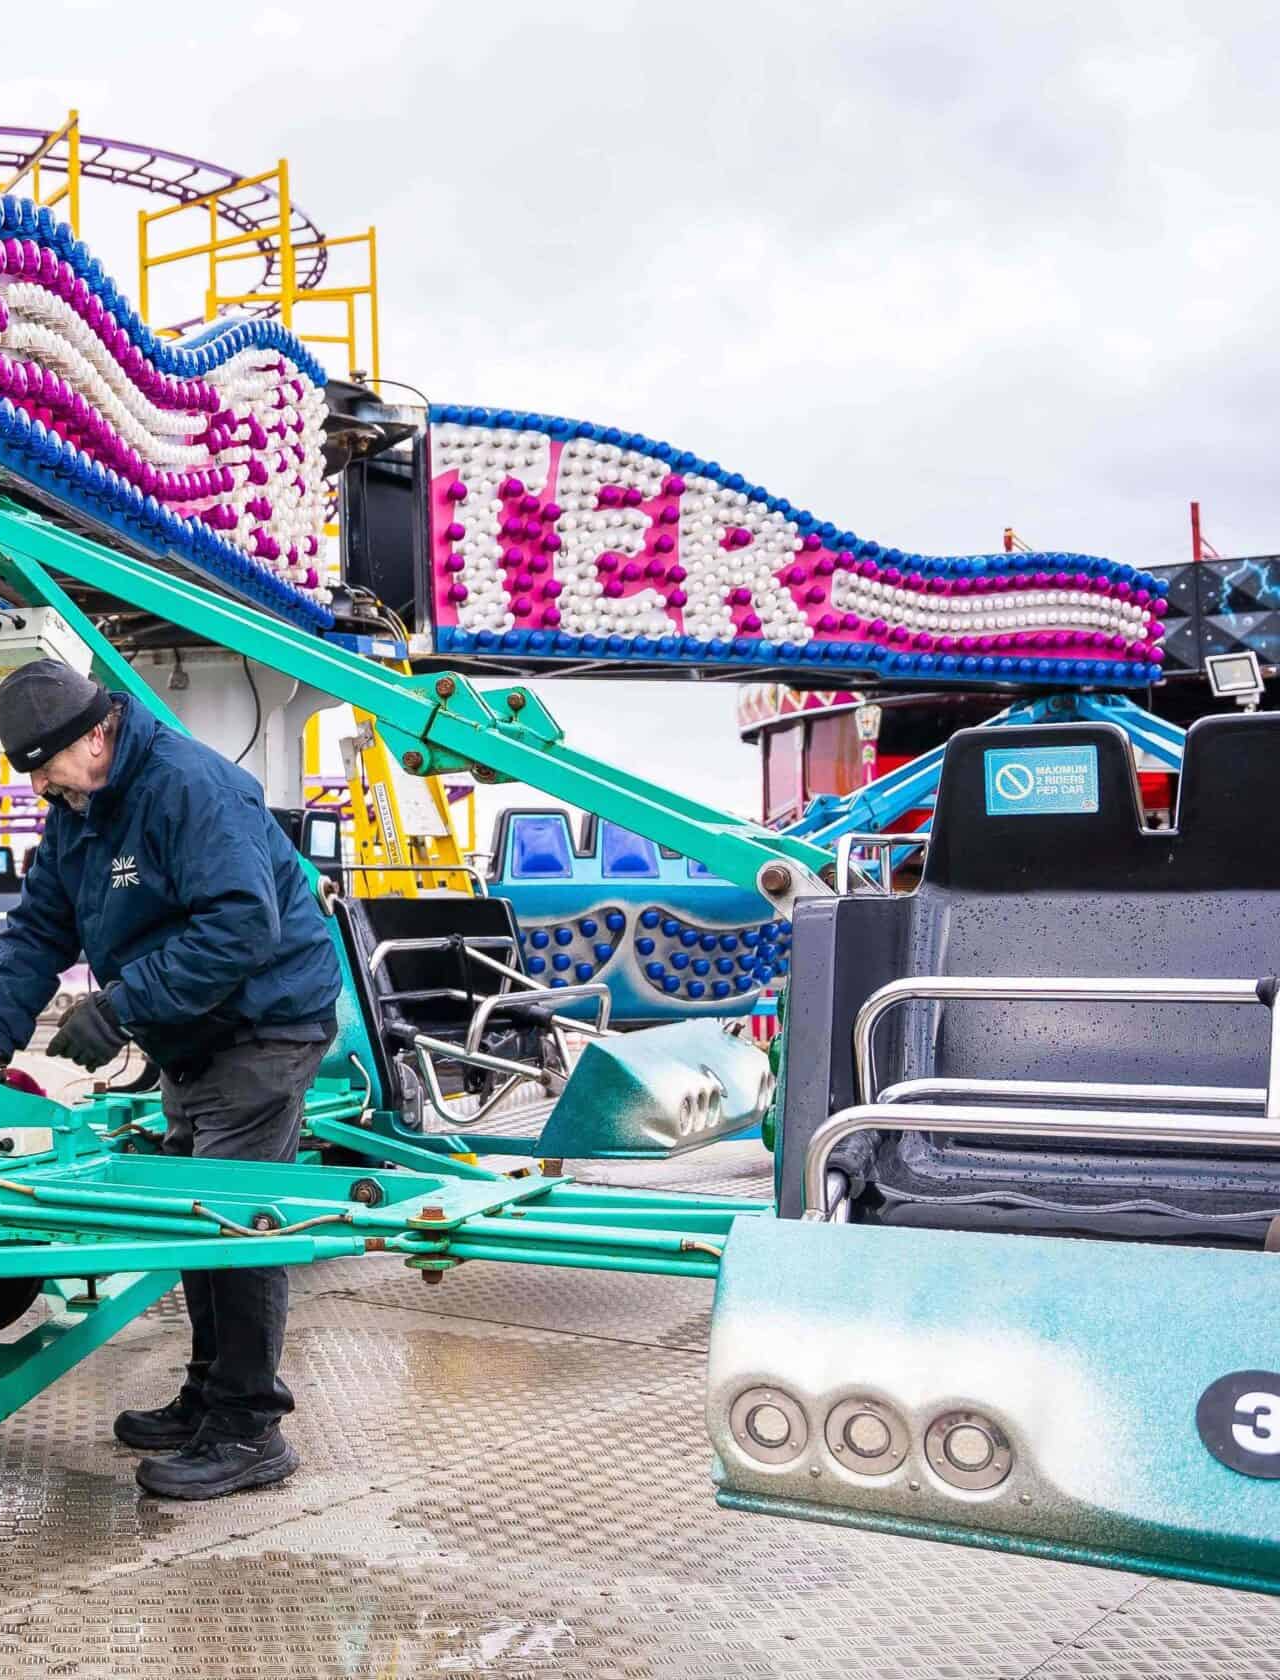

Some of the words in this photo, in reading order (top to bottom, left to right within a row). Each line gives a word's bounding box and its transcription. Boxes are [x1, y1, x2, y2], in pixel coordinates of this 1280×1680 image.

[431, 423, 814, 645] TER
[1035, 765, 1087, 776] MAXIMUM
[1045, 776, 1085, 785] RIDERS
[1036, 785, 1058, 794] PER
[1061, 784, 1084, 793] CAR
[1231, 1391, 1280, 1454] 3
